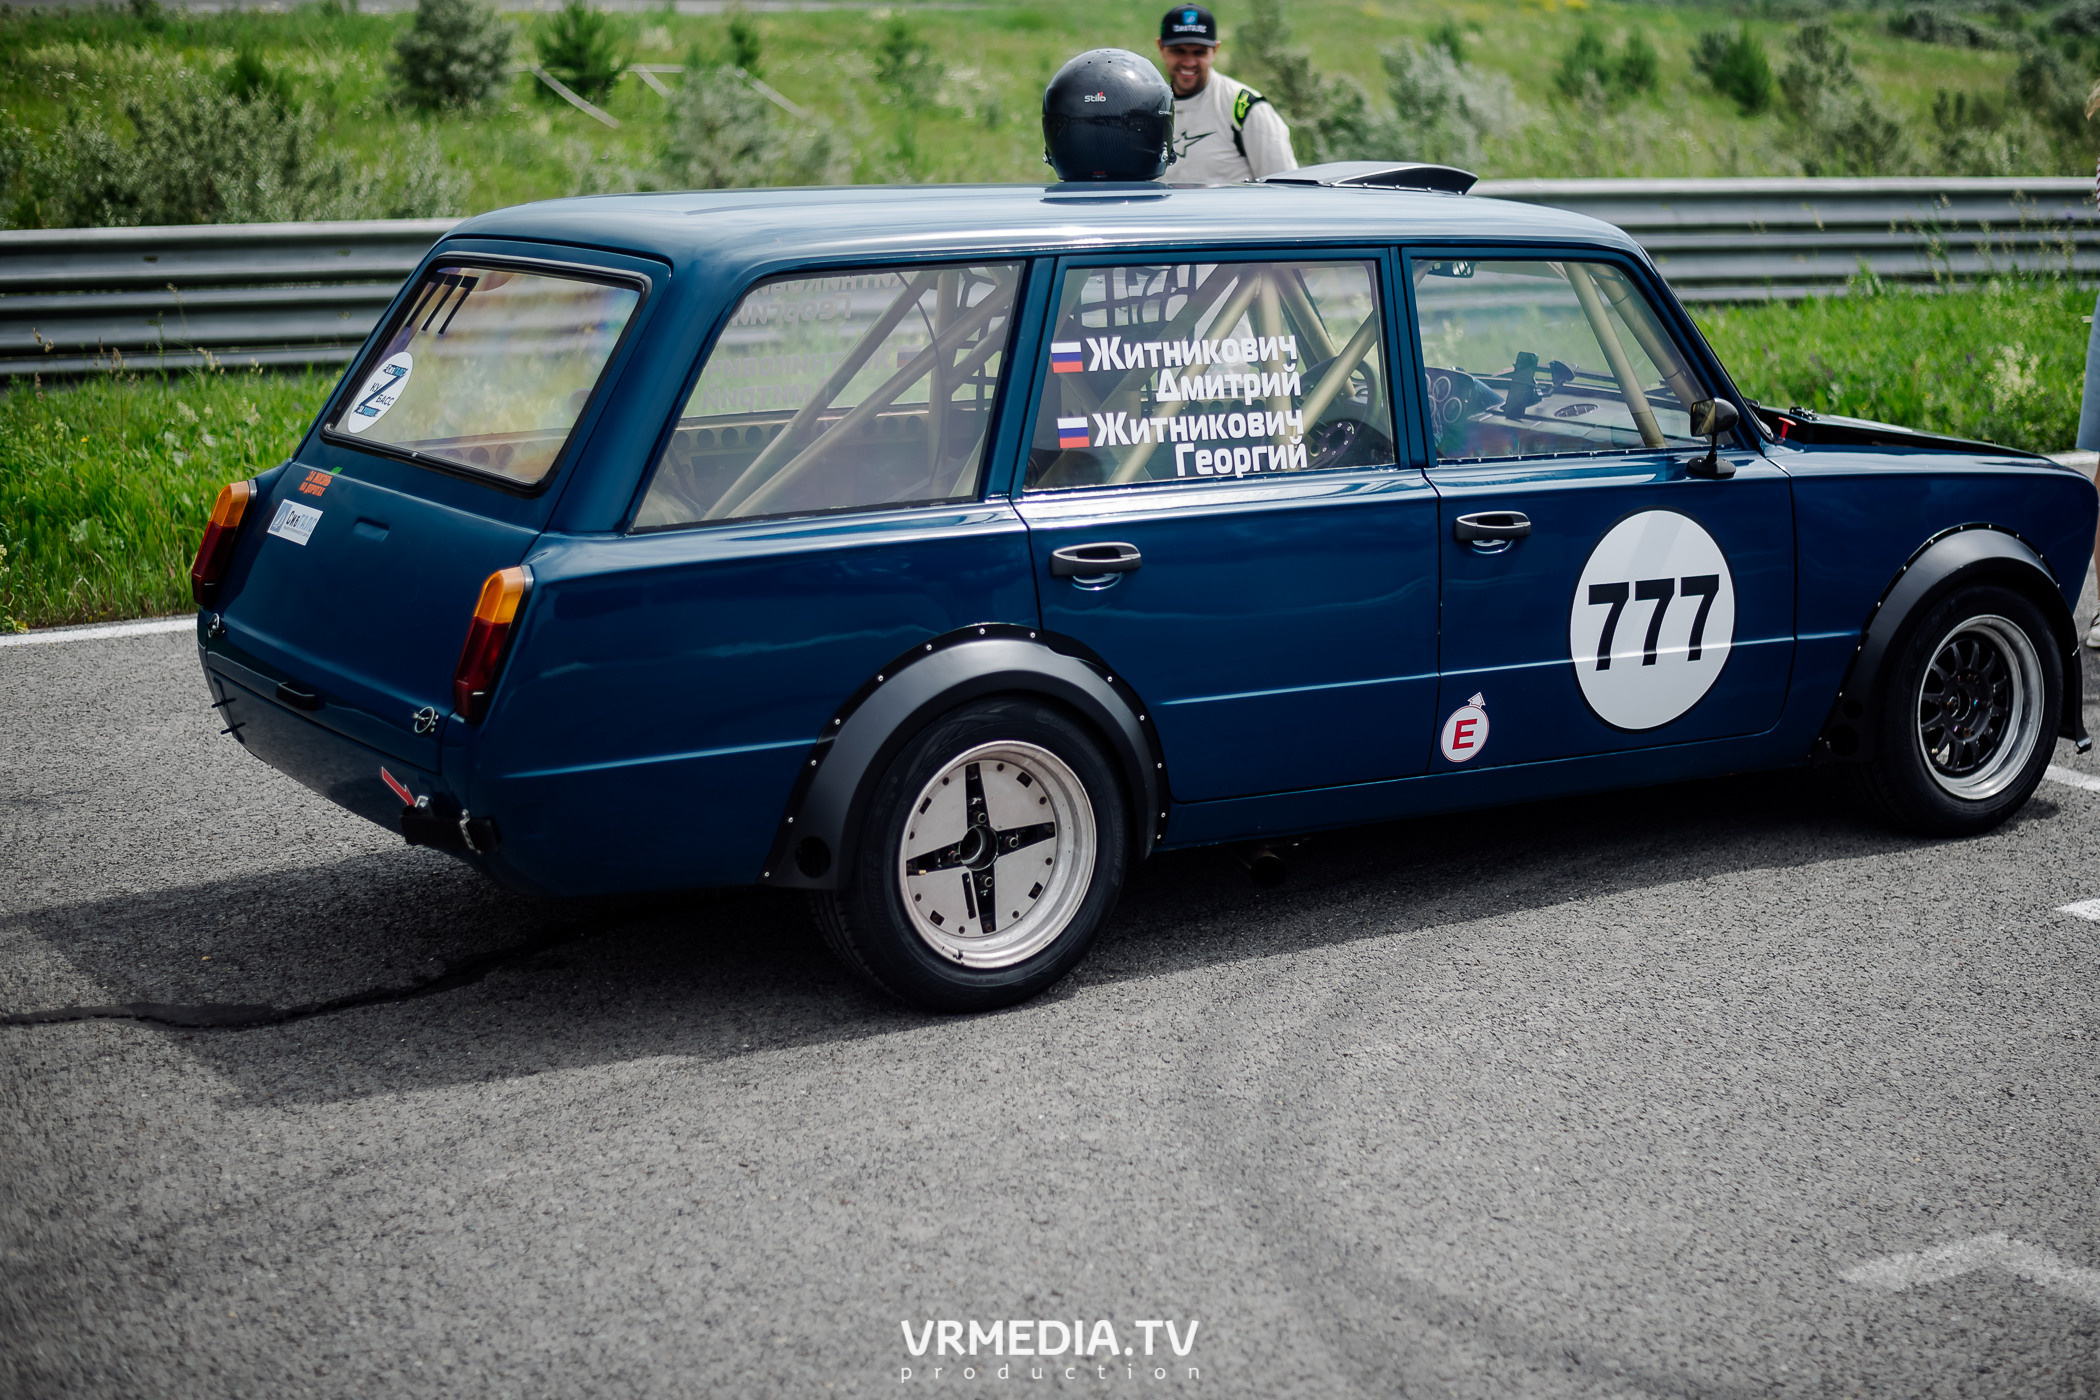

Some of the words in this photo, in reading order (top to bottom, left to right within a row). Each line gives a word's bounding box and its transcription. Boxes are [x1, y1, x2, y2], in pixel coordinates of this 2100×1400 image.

[405, 272, 480, 335] 777
[1085, 335, 1298, 373] Житникович
[1156, 363, 1302, 406] Дмитрий
[1092, 410, 1304, 447] Житникович
[1175, 436, 1308, 478] Георгий
[1588, 574, 1720, 671] 777
[1452, 718, 1478, 750] E
